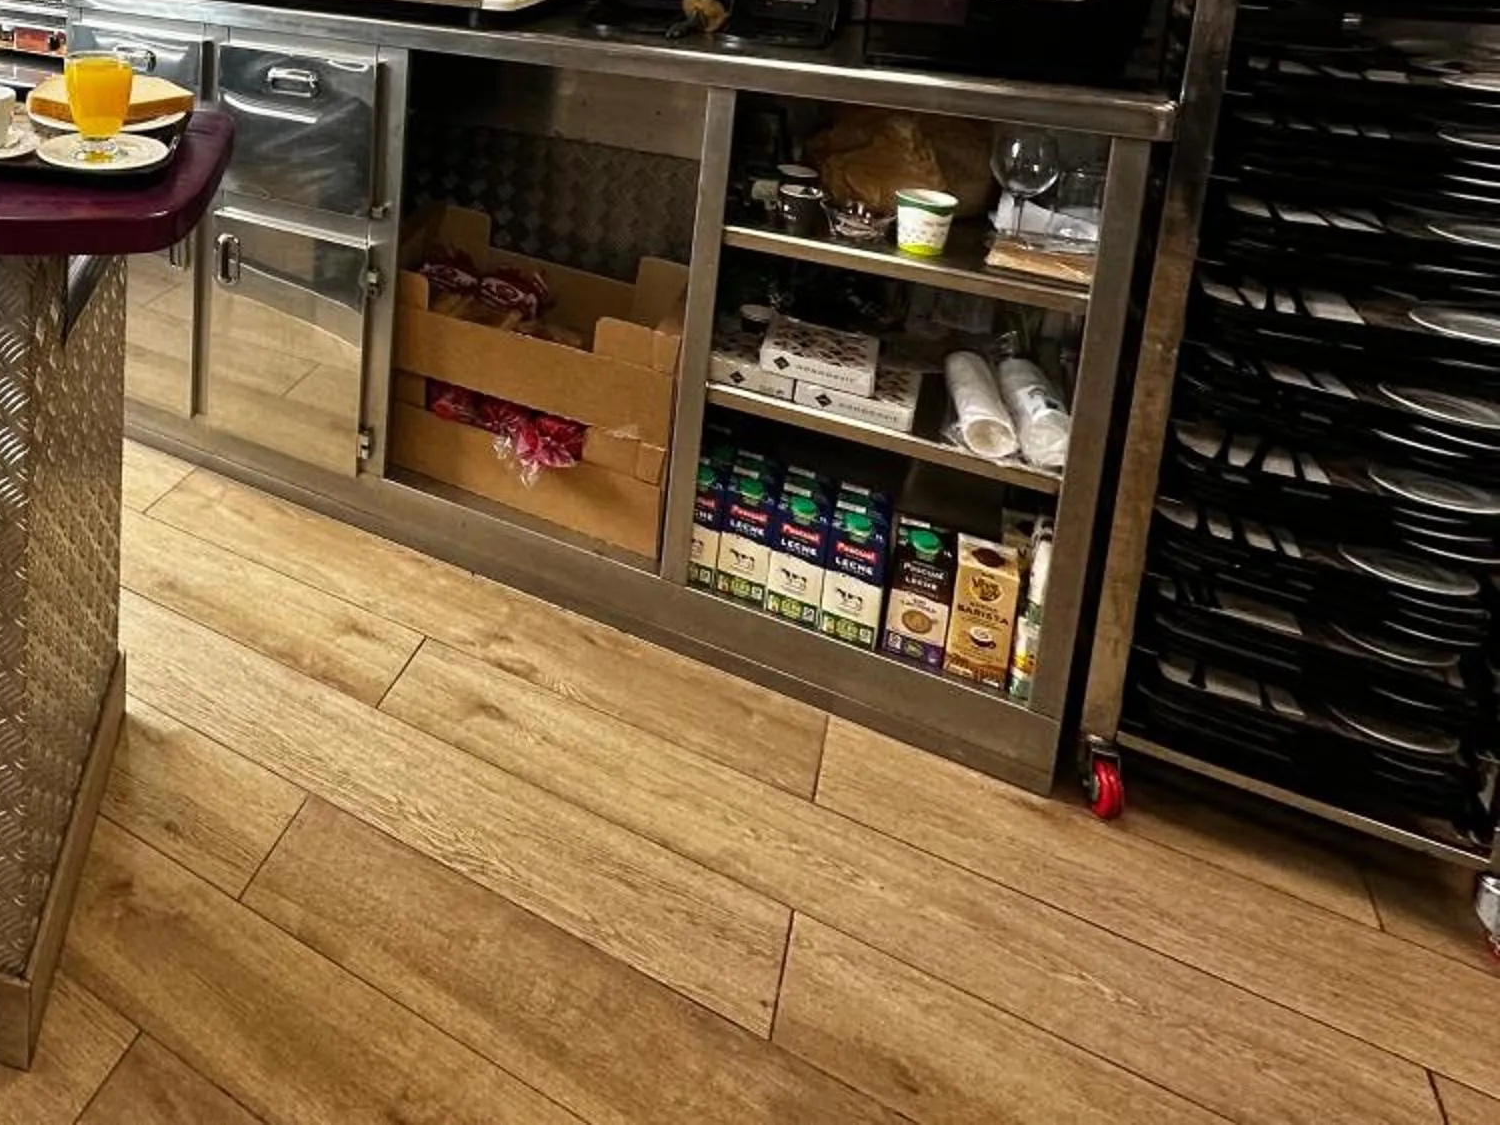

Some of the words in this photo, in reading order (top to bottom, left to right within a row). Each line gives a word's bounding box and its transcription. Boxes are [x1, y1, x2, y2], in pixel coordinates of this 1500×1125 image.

[729, 518, 765, 536] LECHE
[781, 537, 817, 557] LECHE
[835, 556, 873, 575] LECHE
[957, 604, 1009, 626] BARISTA
